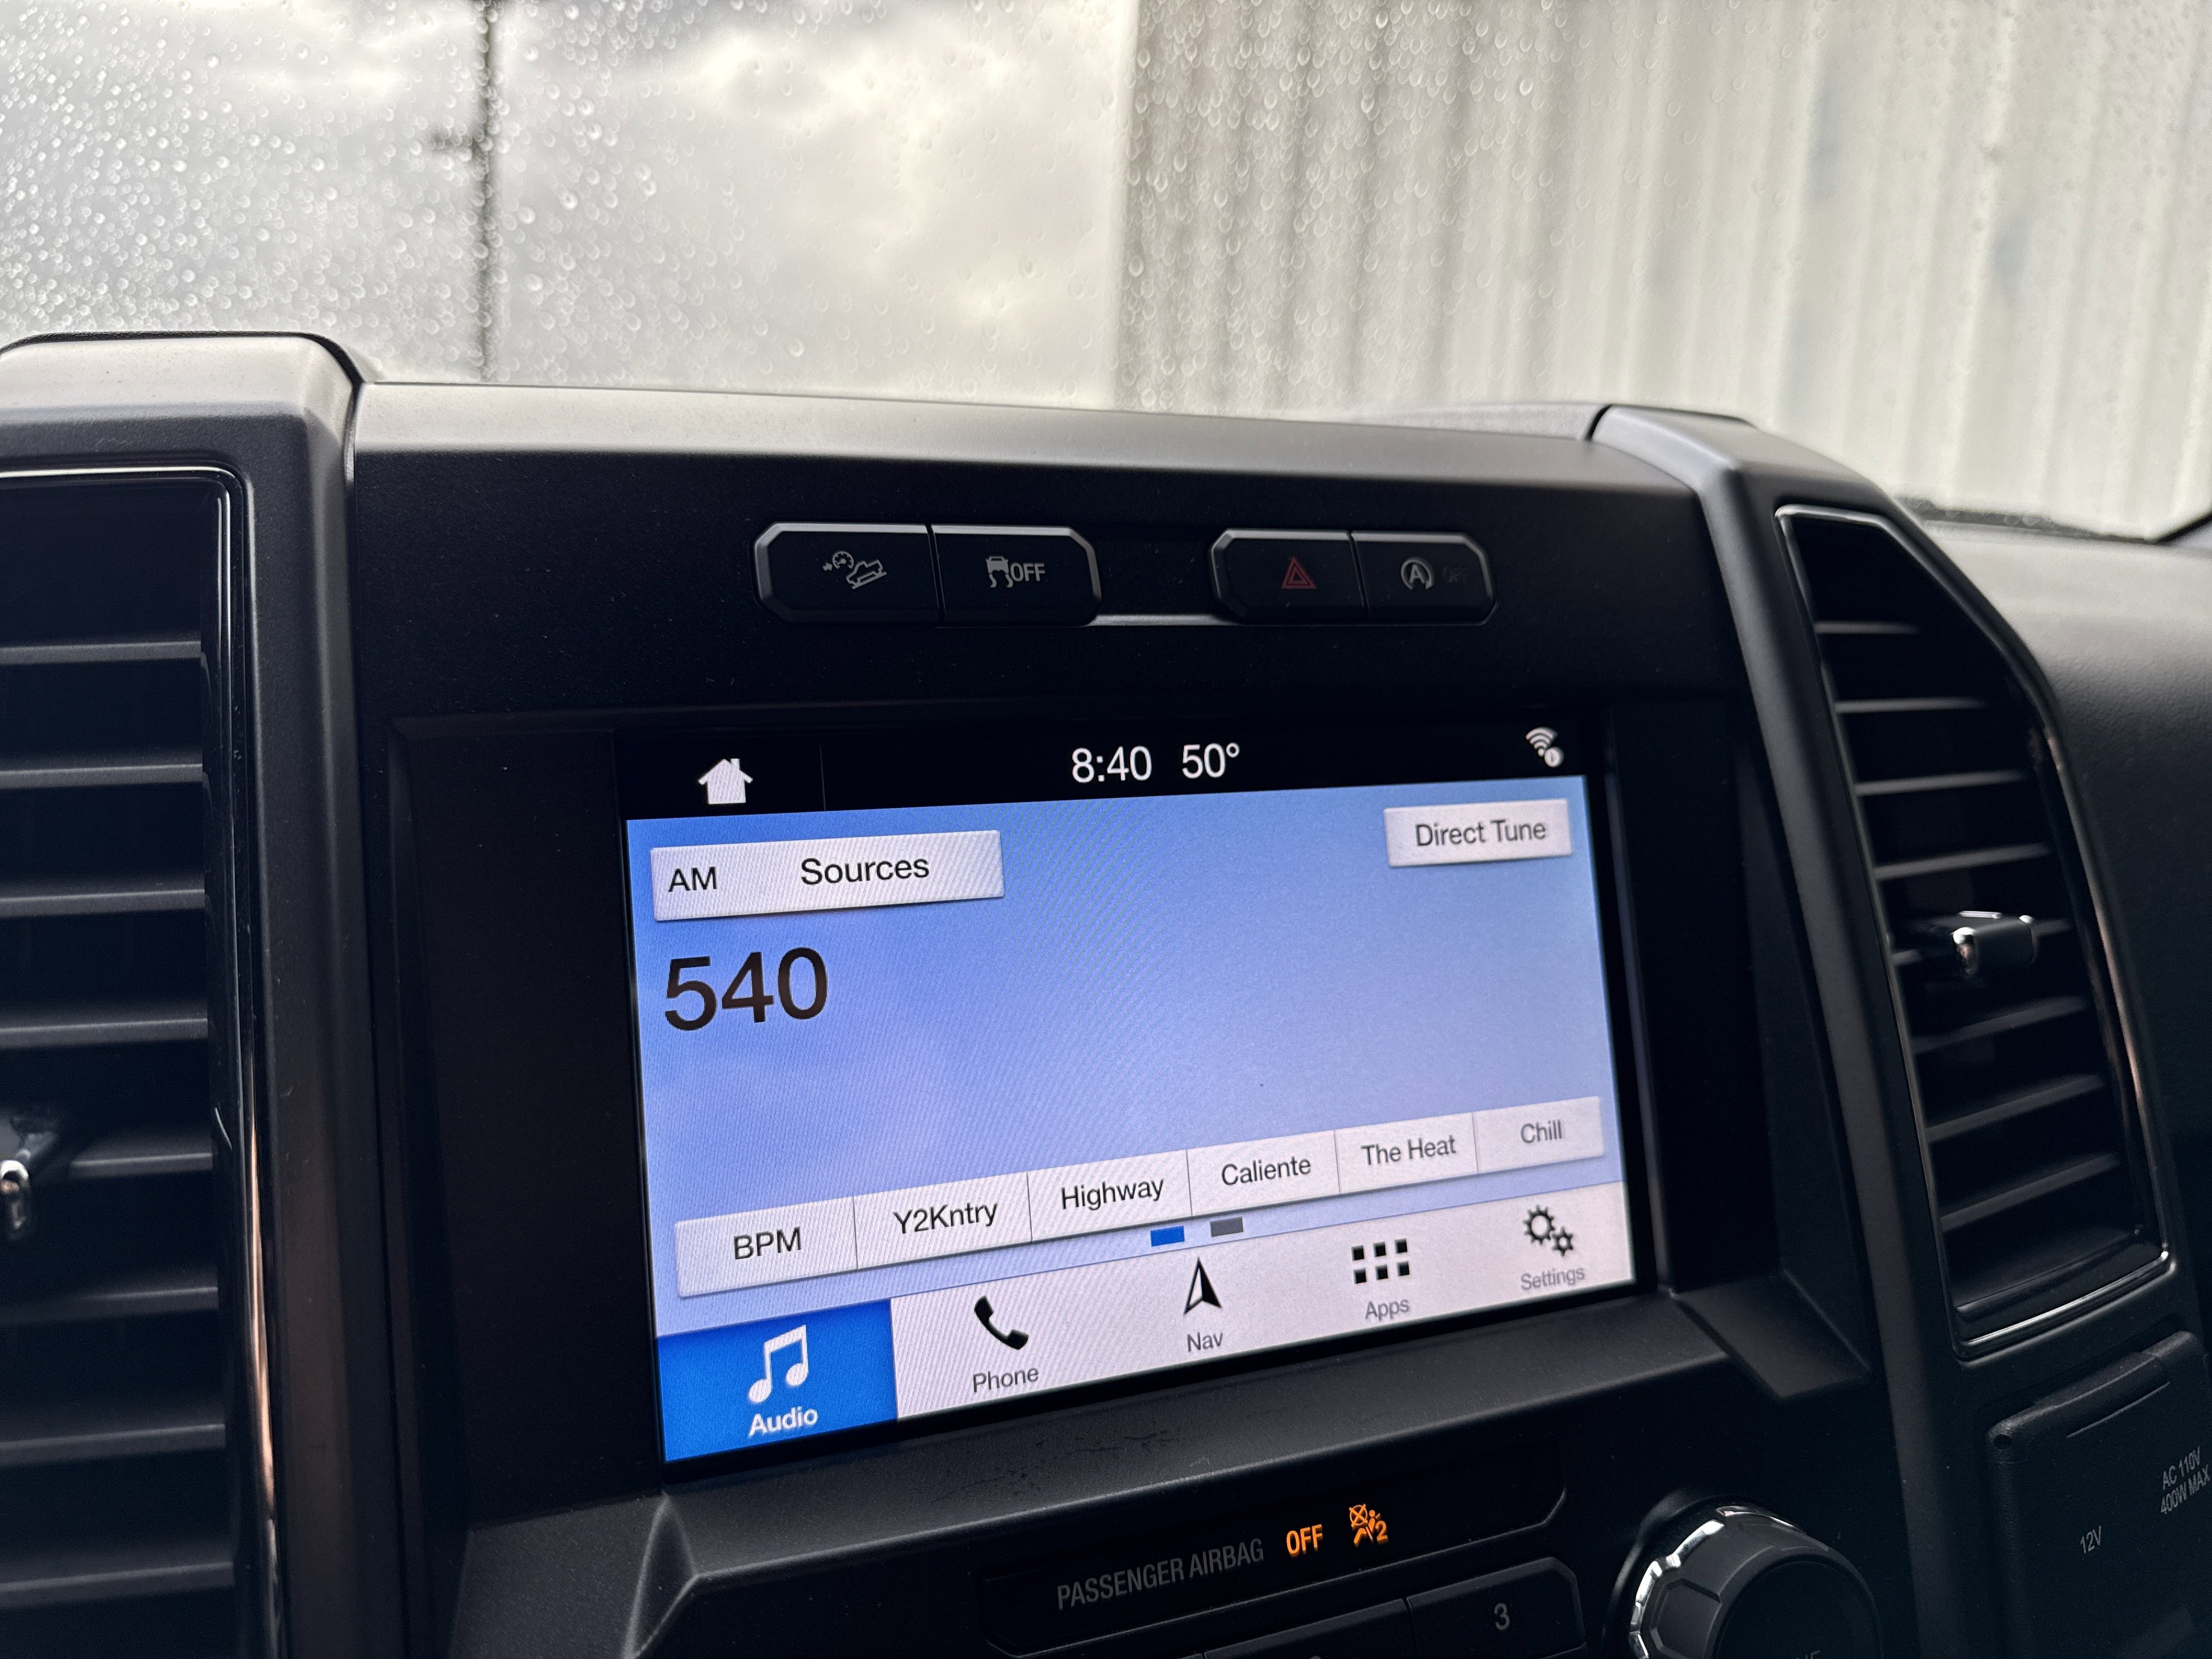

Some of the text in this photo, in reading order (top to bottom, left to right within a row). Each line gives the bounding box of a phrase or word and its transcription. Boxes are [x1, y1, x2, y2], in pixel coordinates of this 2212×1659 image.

[1010, 562, 1045, 582] OFF
[1073, 746, 1152, 782] 8:40
[1183, 743, 1239, 778] 50°
[1415, 819, 1546, 847] Direct Tune
[668, 867, 716, 892] AM
[802, 858, 929, 885] Sources
[665, 947, 827, 1031] 540
[1521, 1120, 1562, 1144] Chill
[1361, 1135, 1456, 1165] The Heat
[1222, 1156, 1311, 1186] Caliente
[1062, 1180, 1163, 1210] Highway
[893, 1203, 997, 1234] Y2Kntry
[734, 1227, 801, 1260] BPM
[1521, 1268, 1585, 1290] Settings
[1365, 1299, 1410, 1322] Apps
[1187, 1332, 1223, 1352] Nav
[973, 1368, 1039, 1394] Phone
[749, 1406, 817, 1437] Audio
[2163, 1446, 2201, 1490] AC 110V
[2160, 1463, 2211, 1515] 400W MAX
[2080, 1526, 2101, 1553] 12V
[1058, 1523, 1323, 1610] PASSENGER AIRBAG OFF
[1494, 1603, 1510, 1630] 3
